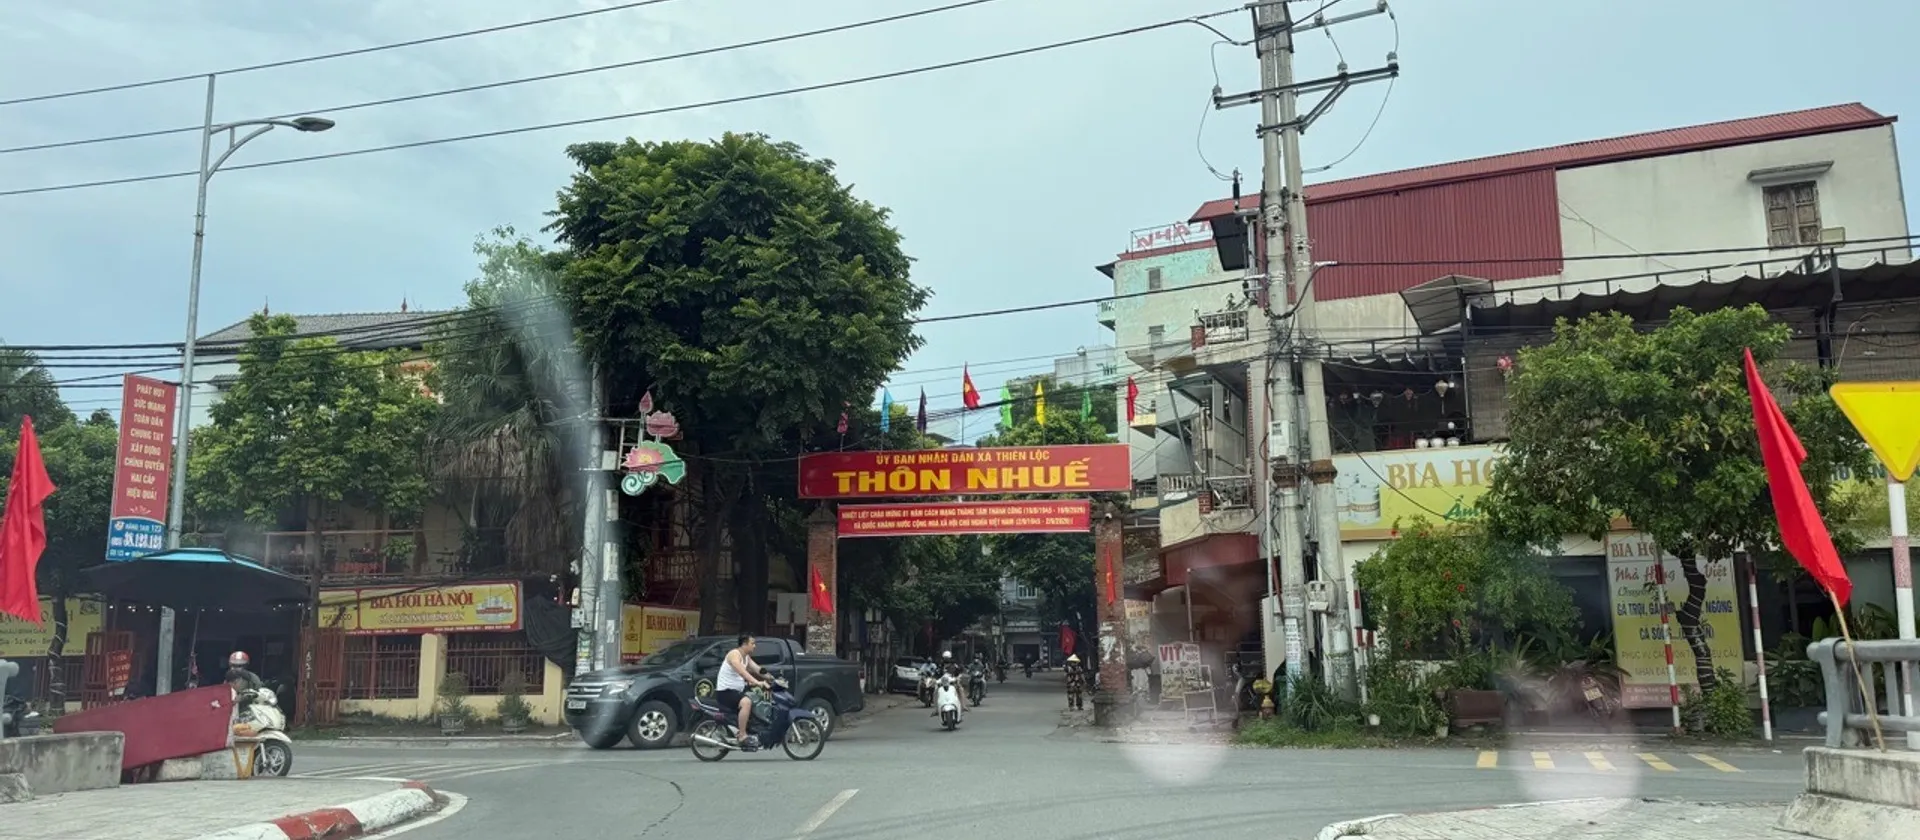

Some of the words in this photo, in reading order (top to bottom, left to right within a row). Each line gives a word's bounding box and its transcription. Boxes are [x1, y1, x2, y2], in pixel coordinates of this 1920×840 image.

[136, 384, 153, 395] PHÁT
[153, 387, 165, 398] HUY
[133, 413, 150, 424] TOÀN
[150, 416, 164, 427] DÂN
[130, 428, 152, 440] CHUNG
[153, 431, 164, 442] TAY
[130, 441, 143, 453] XÂY
[124, 456, 144, 468] CHÍNH
[144, 459, 165, 472] QUYỀN
[893, 455, 915, 465] BAN
[918, 453, 948, 464] NHÂN
[952, 452, 974, 463] DÂN
[996, 450, 1028, 461] THIÊN
[1030, 449, 1050, 462] LỘC
[130, 472, 142, 483] HAI
[143, 473, 156, 485] CẤP
[832, 465, 951, 493] THÔN
[967, 457, 1091, 489] NHUẾ
[1386, 462, 1443, 490] BIA
[126, 487, 141, 500] HIỆU
[1611, 542, 1634, 558] BIA
[1615, 566, 1640, 582] Nhà
[370, 594, 393, 609] BIA
[395, 592, 421, 608] HƠI
[424, 589, 445, 607] HÀ
[447, 589, 474, 609] NỘI
